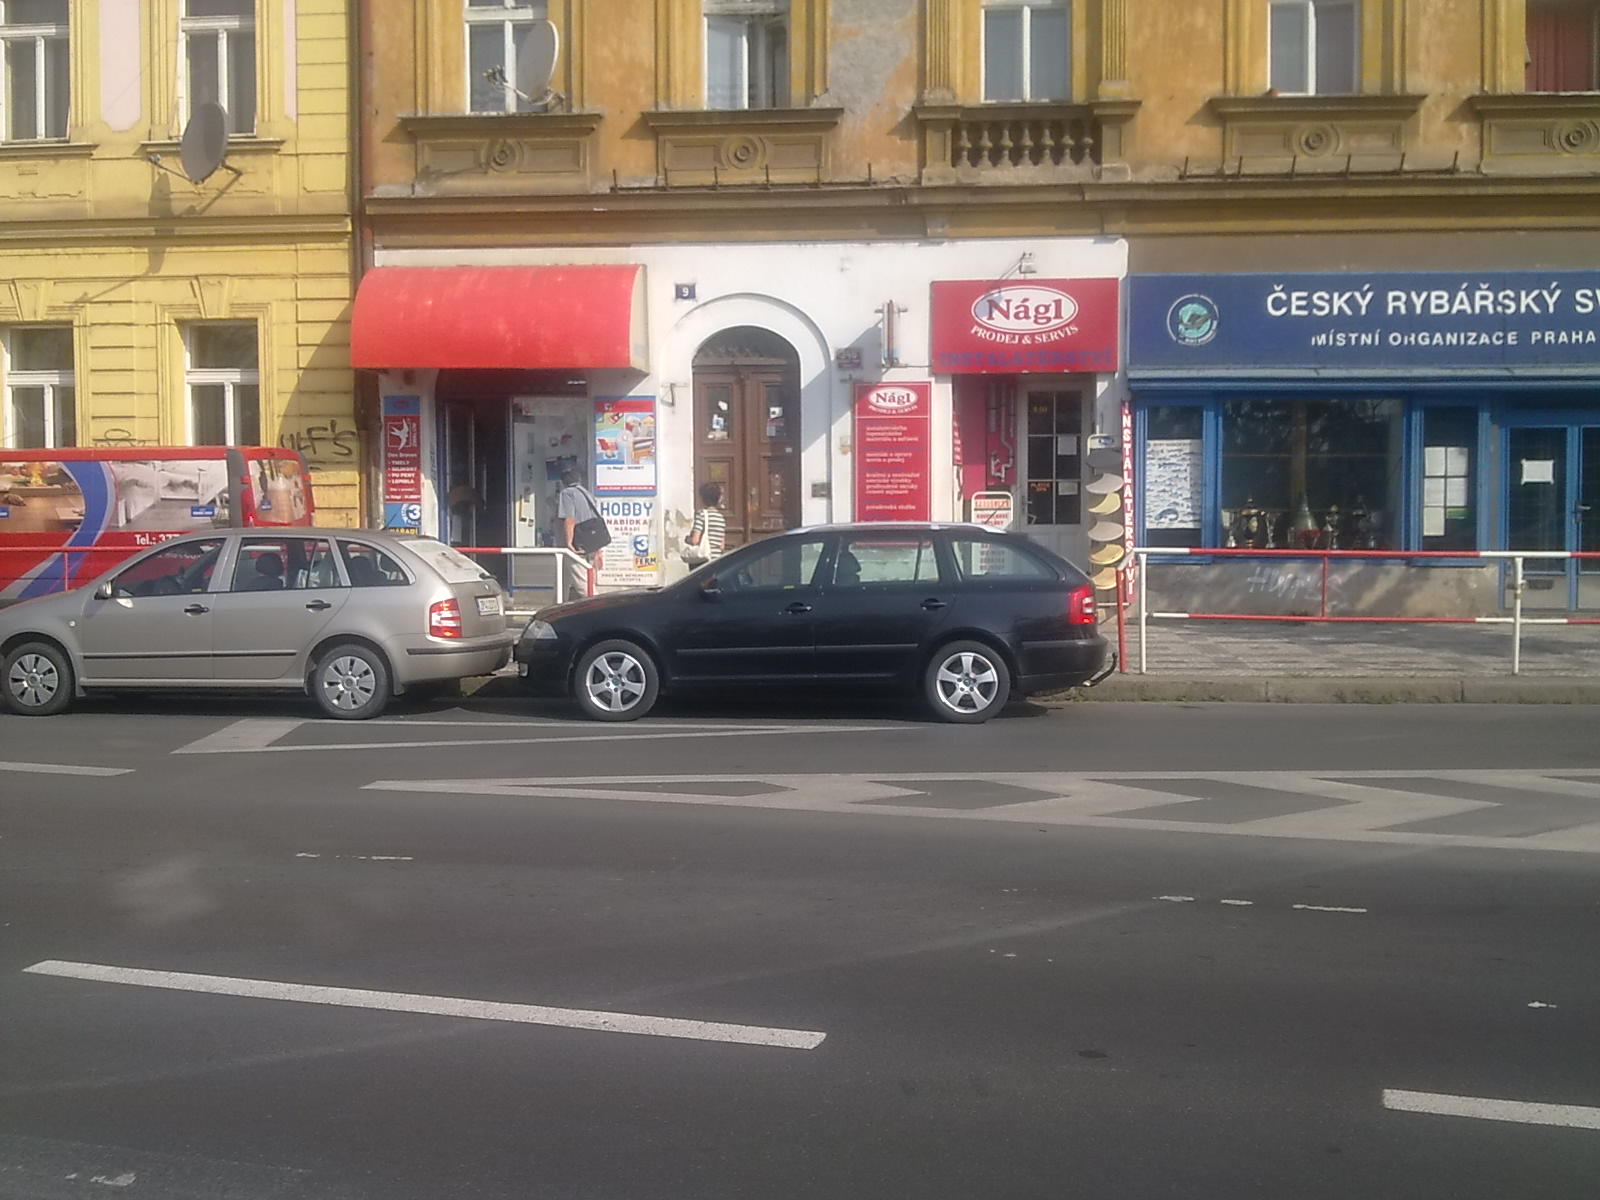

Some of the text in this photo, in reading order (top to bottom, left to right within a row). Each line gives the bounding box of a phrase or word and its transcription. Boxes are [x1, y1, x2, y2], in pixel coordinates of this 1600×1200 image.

[1266, 281, 1600, 317] ČESKÝ RYBÁŘSKÝ S
[986, 298, 1064, 326] Nágl
[970, 324, 1079, 345] PRODEJ & SERVIS
[1311, 328, 1381, 347] MÍSTNÍ
[1530, 331, 1597, 345] PRAHA
[875, 391, 911, 406] Nágl
[600, 502, 653, 517] HOBBY
[606, 518, 649, 526] NABÍDKA
[133, 533, 157, 546] Tel.:
[635, 557, 657, 566] FERM
